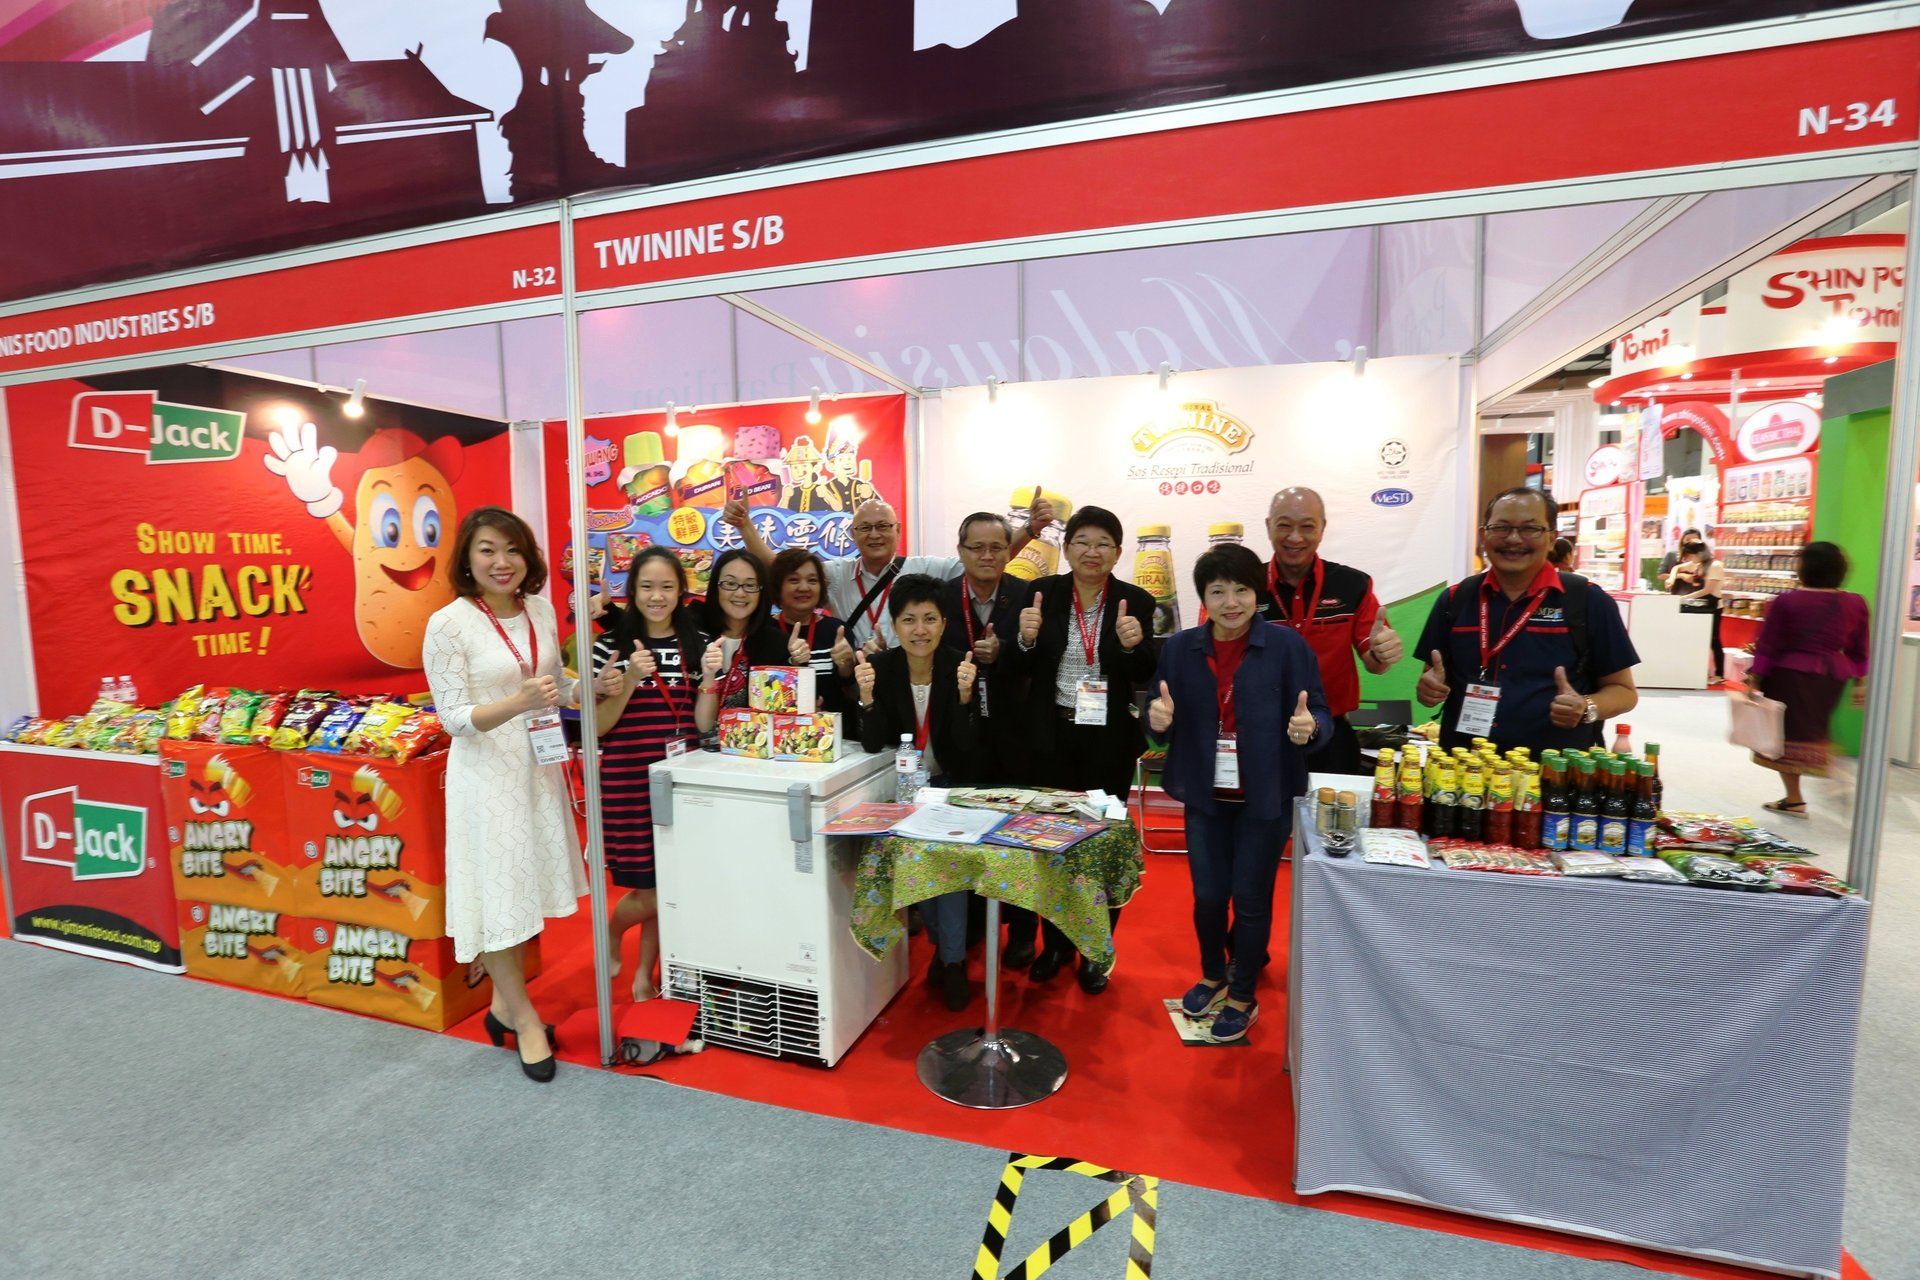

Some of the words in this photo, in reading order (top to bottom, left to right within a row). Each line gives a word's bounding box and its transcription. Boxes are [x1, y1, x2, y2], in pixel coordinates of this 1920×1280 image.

[1798, 99, 1897, 136] N-34
[594, 223, 724, 268] TWININE
[732, 215, 784, 250] S/B
[512, 267, 556, 288] N-32
[25, 326, 73, 354] FOOD
[75, 308, 180, 345] INDUSTRIES
[183, 302, 215, 329] S/B
[91, 406, 233, 452] D-Jack
[1127, 466, 1147, 478] Sos
[1150, 464, 1188, 479] Resepi
[1190, 460, 1254, 476] Tradisional
[1375, 492, 1411, 504] MeSTI
[110, 563, 306, 628] SNACK
[32, 812, 138, 864] D-Jack
[183, 820, 252, 850] ANGRY
[181, 850, 224, 877] BITE
[323, 835, 402, 868] ANGRY
[320, 867, 367, 897] BITE
[208, 903, 277, 934] ANGRY
[204, 932, 247, 957] BITE
[333, 925, 409, 959] ANGRY
[327, 955, 375, 984] BITE
